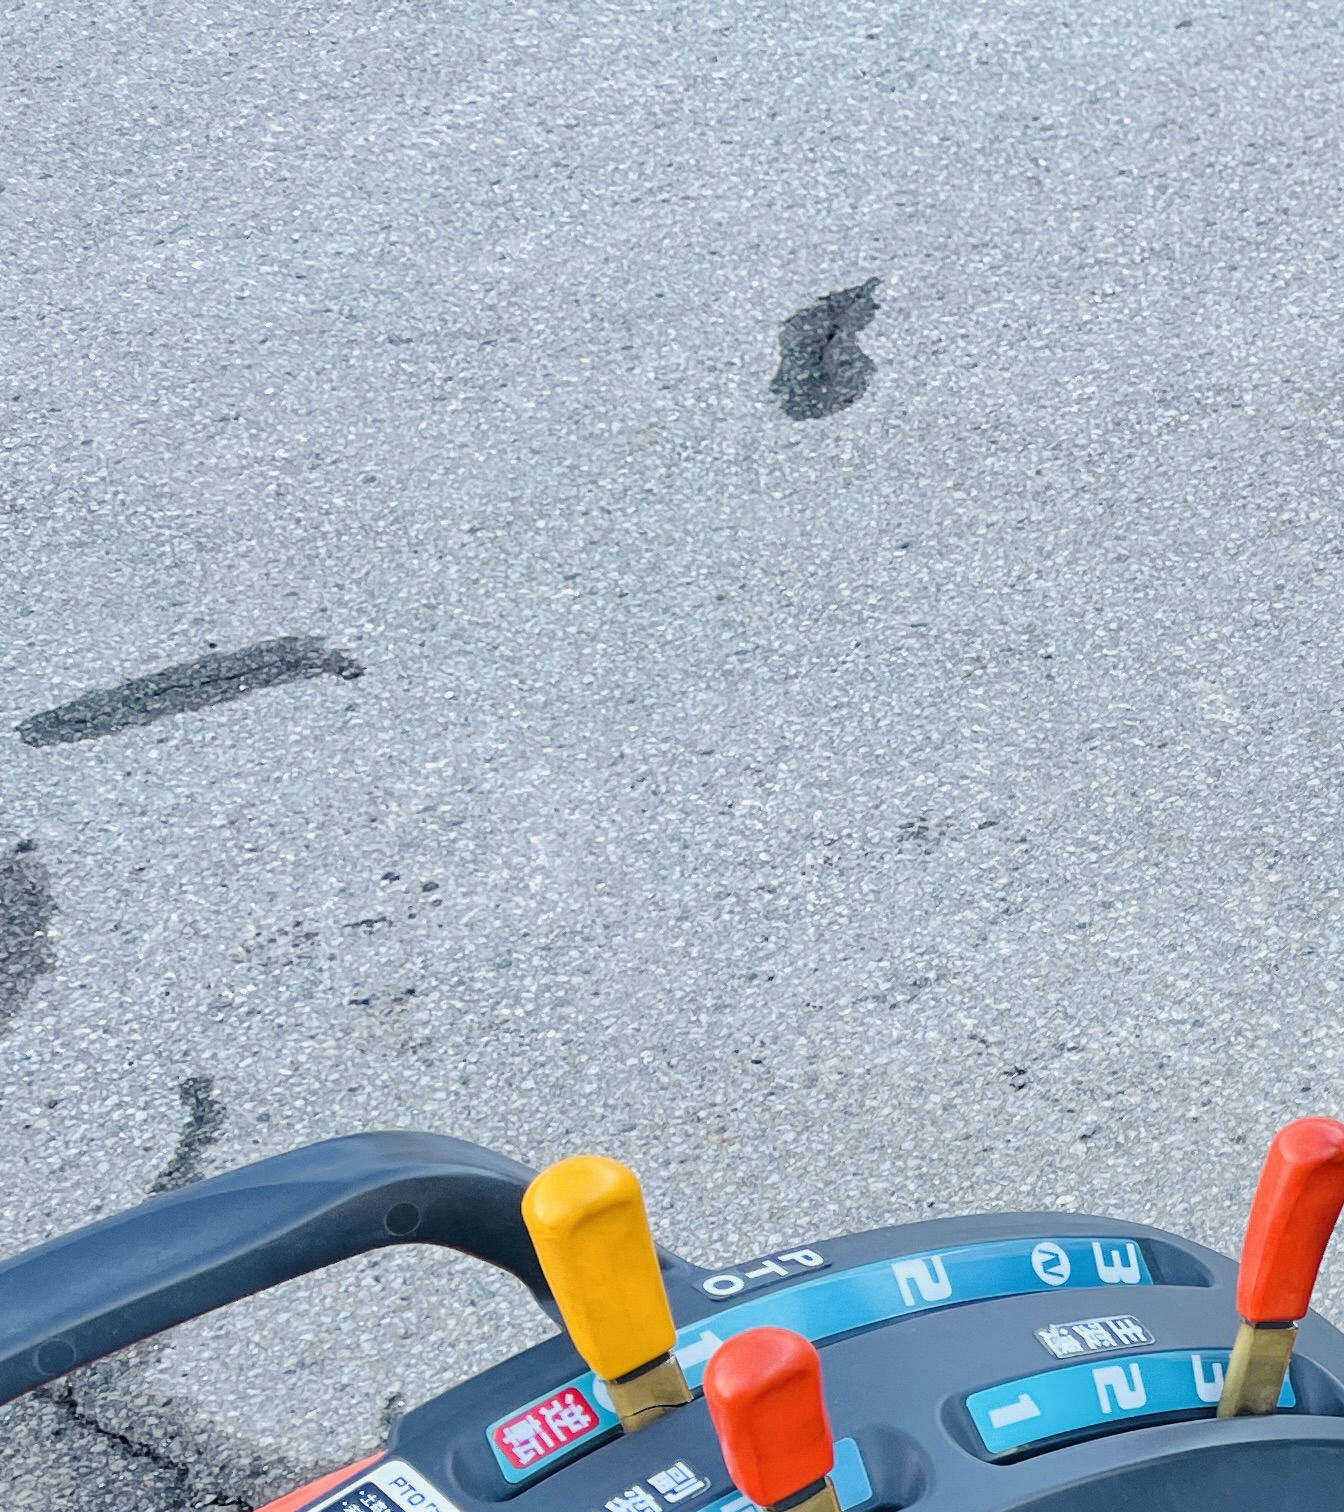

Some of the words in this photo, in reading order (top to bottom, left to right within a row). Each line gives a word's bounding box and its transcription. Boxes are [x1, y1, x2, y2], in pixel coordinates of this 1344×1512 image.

[701, 1248, 825, 1298] PTO
[891, 1254, 953, 1307] 2
[1092, 1242, 1141, 1284] 3
[988, 1393, 1041, 1428] 1
[1092, 1362, 1147, 1414] 2
[502, 1394, 591, 1465] 逆転
